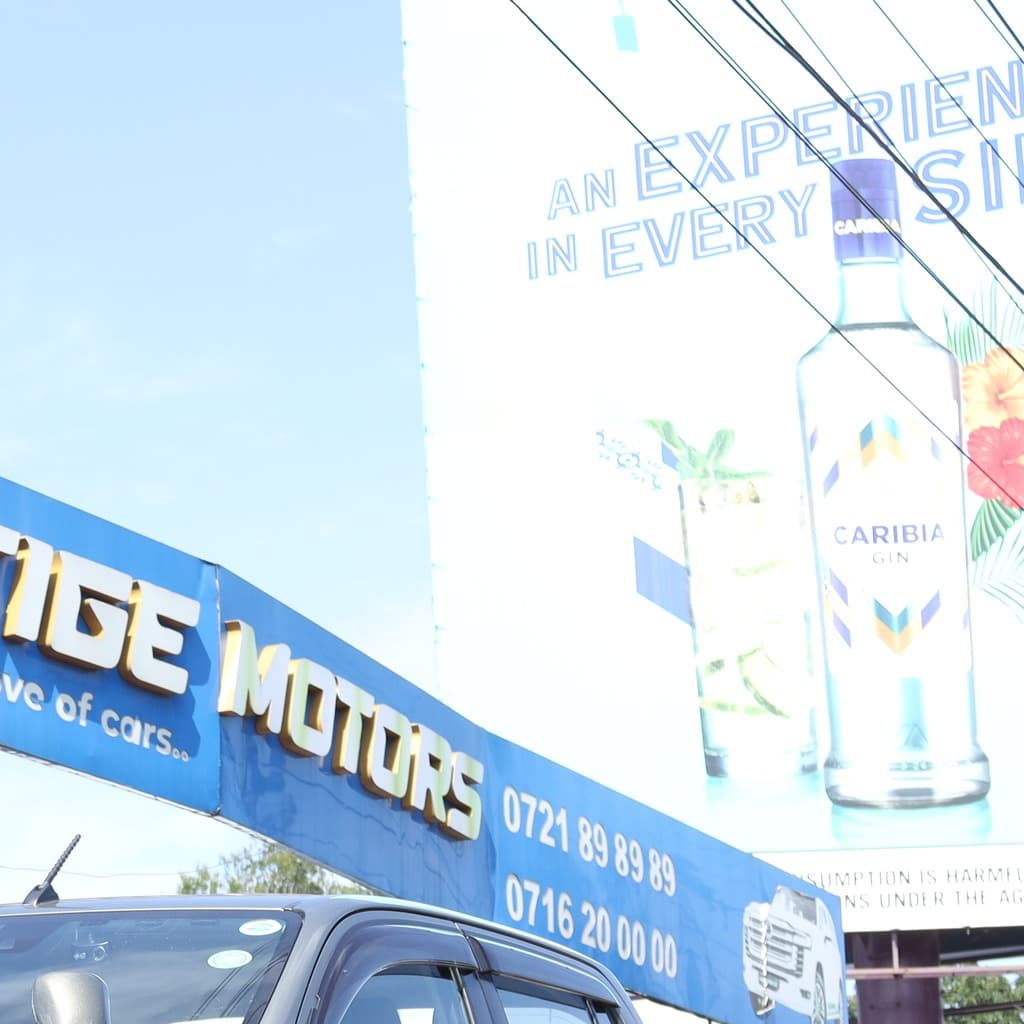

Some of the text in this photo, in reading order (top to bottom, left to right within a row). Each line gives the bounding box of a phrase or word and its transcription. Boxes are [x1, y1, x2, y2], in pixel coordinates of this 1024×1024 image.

[547, 60, 1024, 220] AN EXPERIEN
[527, 133, 1024, 280] IN EVERY SI
[834, 523, 945, 545] CARIBIA
[872, 551, 909, 565] GIN
[54, 691, 94, 727] of
[218, 619, 484, 841] MOTORS
[503, 785, 676, 897] 0721 89 89 89
[879, 891, 944, 909] UNDER
[955, 889, 987, 906] THE
[920, 870, 937, 885] IS
[506, 873, 678, 979] 0716 20 00 00
